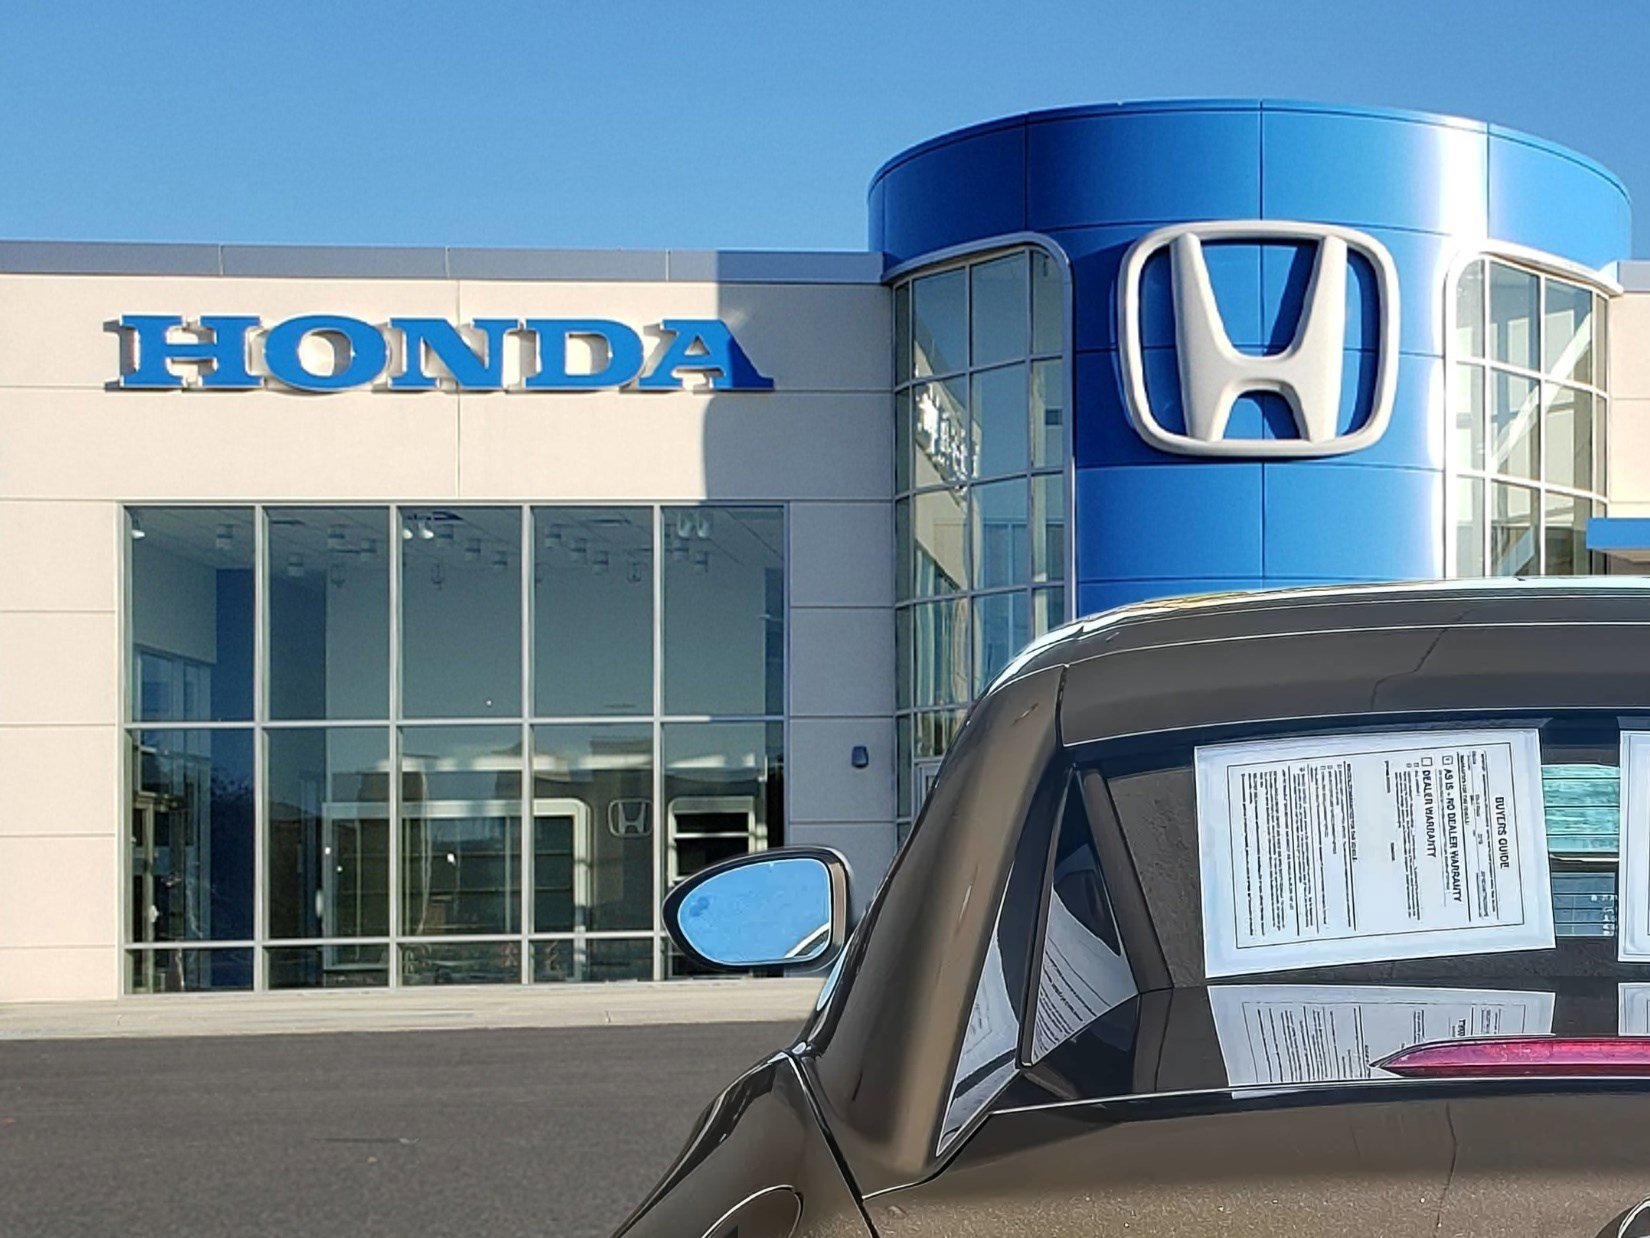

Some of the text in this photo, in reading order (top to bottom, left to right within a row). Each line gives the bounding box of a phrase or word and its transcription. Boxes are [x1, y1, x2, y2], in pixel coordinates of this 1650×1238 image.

[120, 314, 773, 391] HONDA
[1444, 768, 1455, 780] AS
[1445, 782, 1455, 790] IS
[1422, 770, 1436, 858] DEALER WARRANTY
[1446, 798, 1456, 810] NO
[1447, 813, 1458, 849] DEALER
[1495, 796, 1510, 869] BUYERS GUIDE
[1450, 850, 1462, 902] WARRANTY
